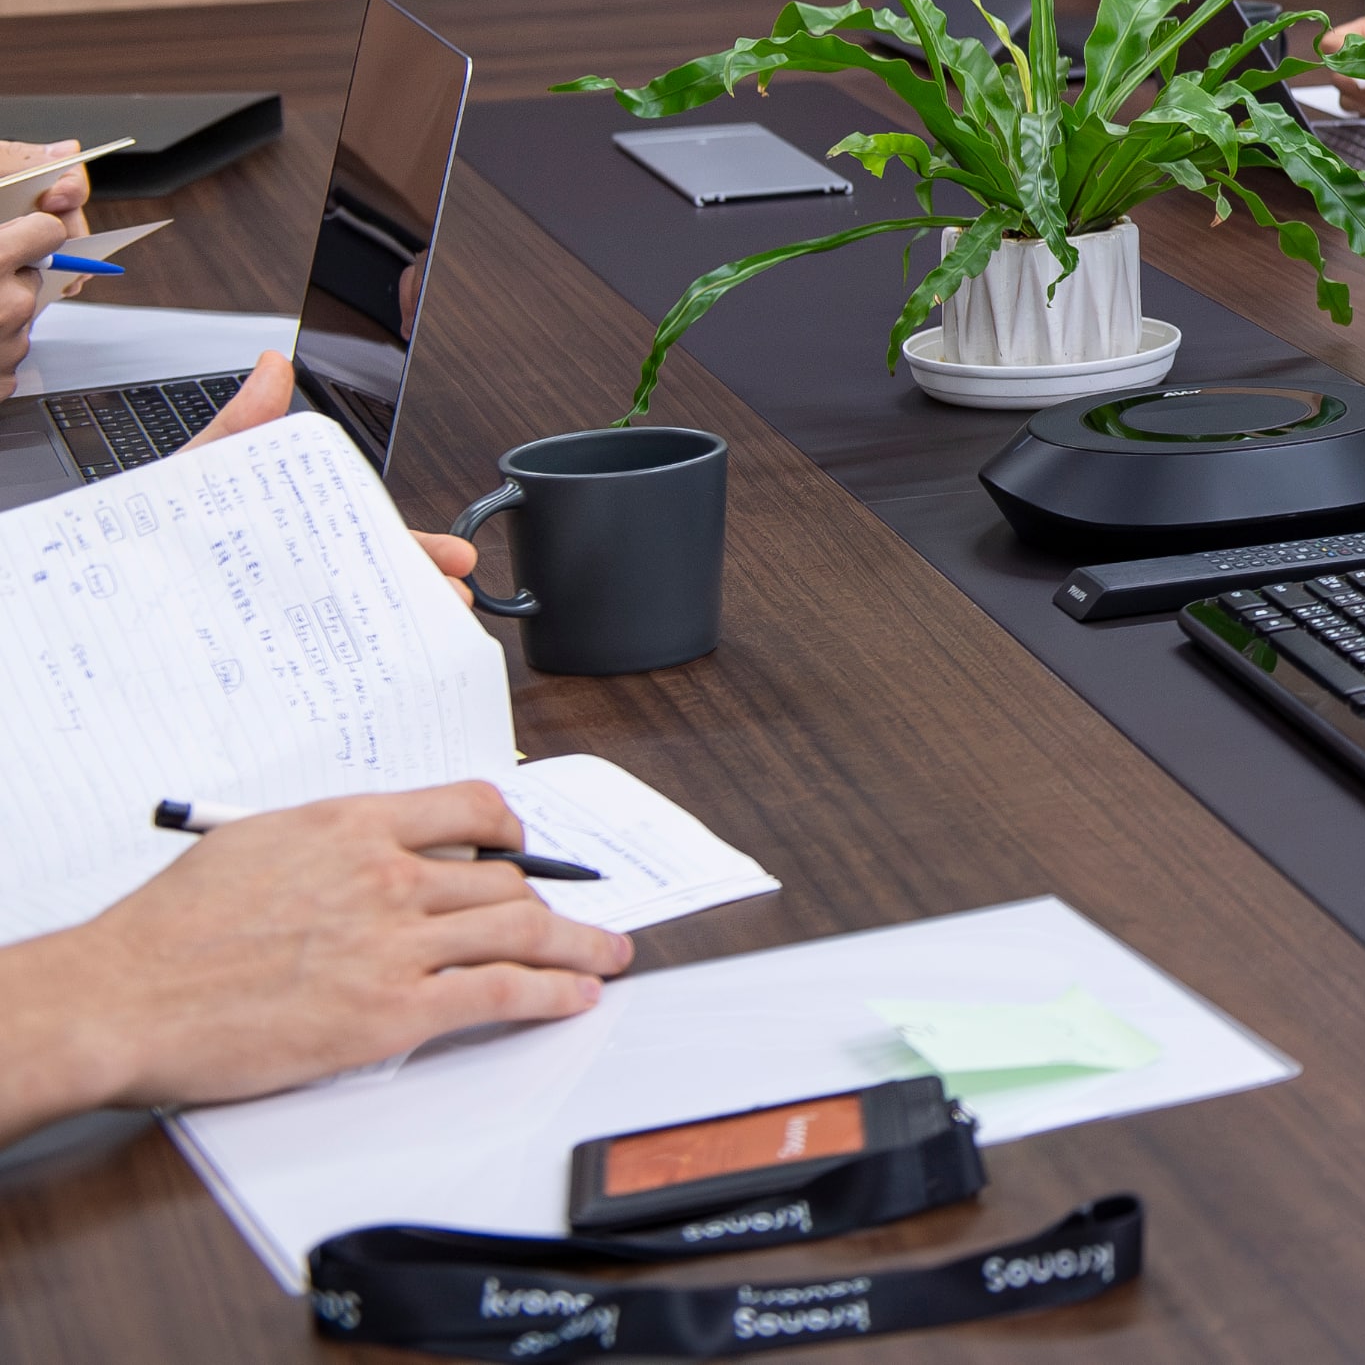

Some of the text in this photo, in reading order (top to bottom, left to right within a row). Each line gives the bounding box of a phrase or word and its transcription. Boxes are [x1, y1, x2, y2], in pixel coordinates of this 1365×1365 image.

[682, 1199, 813, 1242] kronos
[981, 1241, 1116, 1293] kronos
[738, 1277, 872, 1306] kronos
[733, 1299, 872, 1339] kronos
